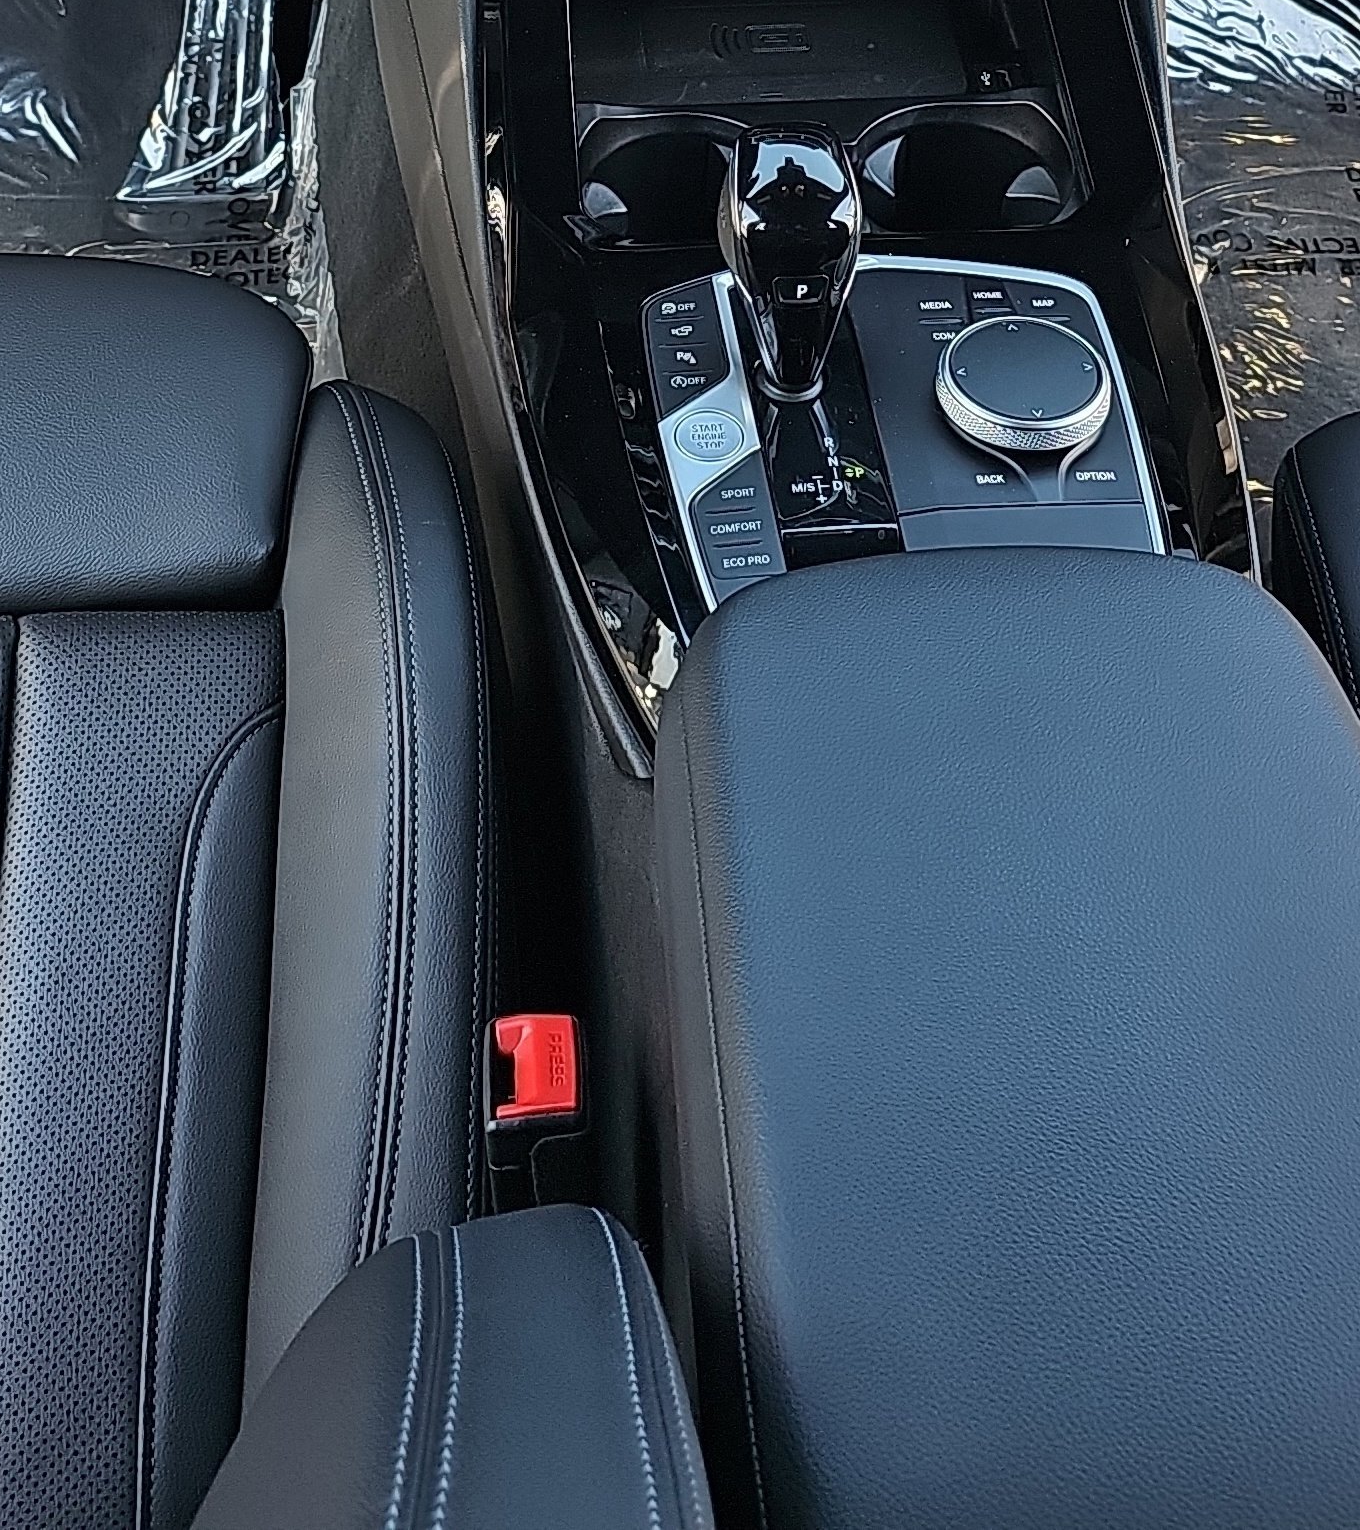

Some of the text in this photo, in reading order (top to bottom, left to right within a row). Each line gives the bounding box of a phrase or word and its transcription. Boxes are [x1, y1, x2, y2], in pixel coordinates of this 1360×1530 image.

[797, 284, 808, 298] P
[972, 291, 1003, 300] HOME
[677, 303, 696, 312] OFF
[919, 301, 952, 311] MEDIA
[1032, 299, 1055, 308] MAP
[687, 376, 707, 385] OFF
[691, 423, 724, 433] START
[691, 432, 727, 441] ENGINE
[696, 440, 725, 449] STOP
[824, 437, 834, 448] R
[827, 456, 839, 467] N
[975, 474, 1006, 484] BACK
[1075, 471, 1117, 482] OPTION
[791, 482, 815, 493] M/S
[832, 480, 843, 491] D
[721, 487, 755, 499] SPORT
[710, 521, 762, 535] COMFORT
[723, 554, 770, 568] ECO PRO
